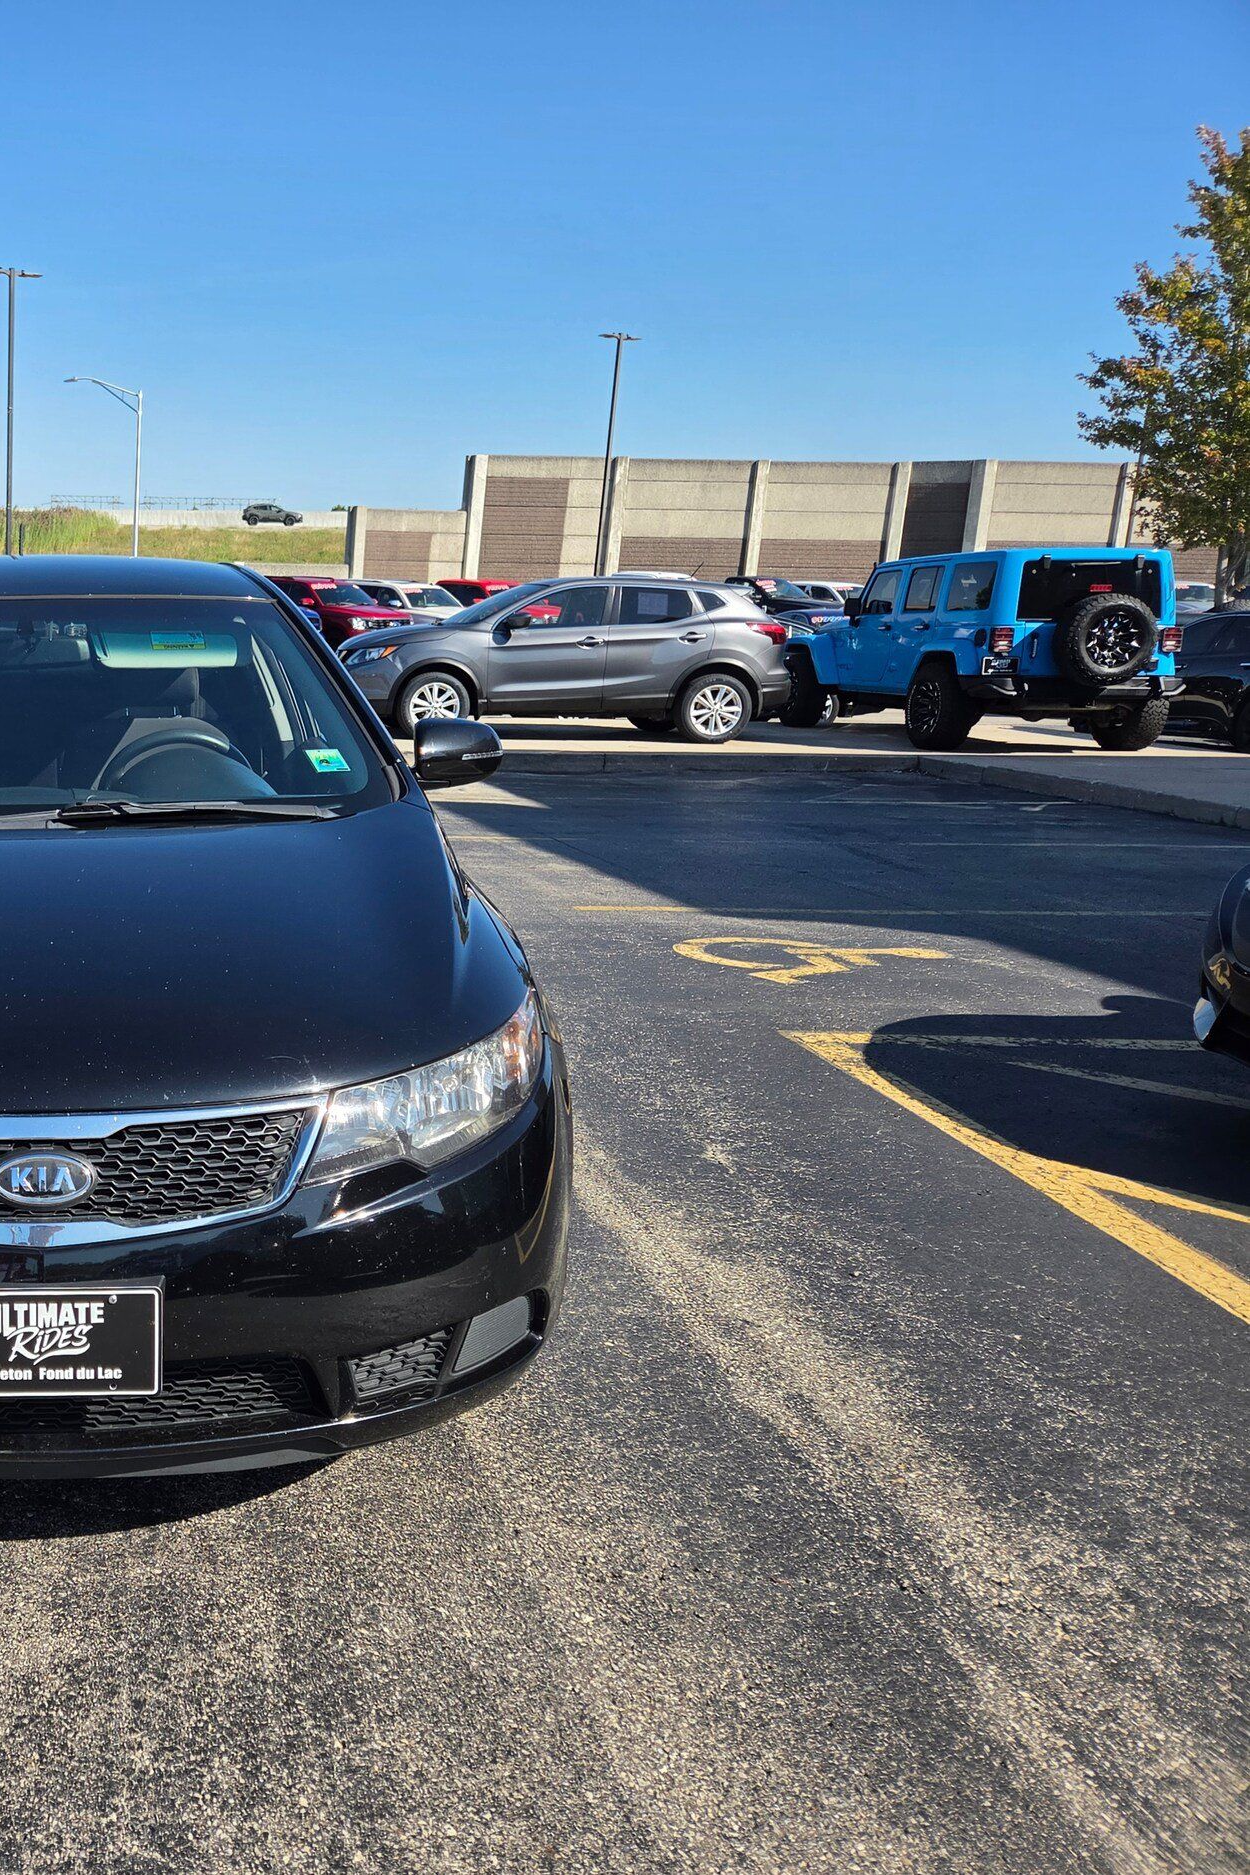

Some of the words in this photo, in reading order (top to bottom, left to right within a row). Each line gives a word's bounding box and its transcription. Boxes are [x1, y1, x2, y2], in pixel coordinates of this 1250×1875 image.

[10, 1166, 76, 1193] KIA
[39, 1367, 74, 1380] Fond
[77, 1367, 95, 1380] du
[98, 1367, 123, 1380] Lac
